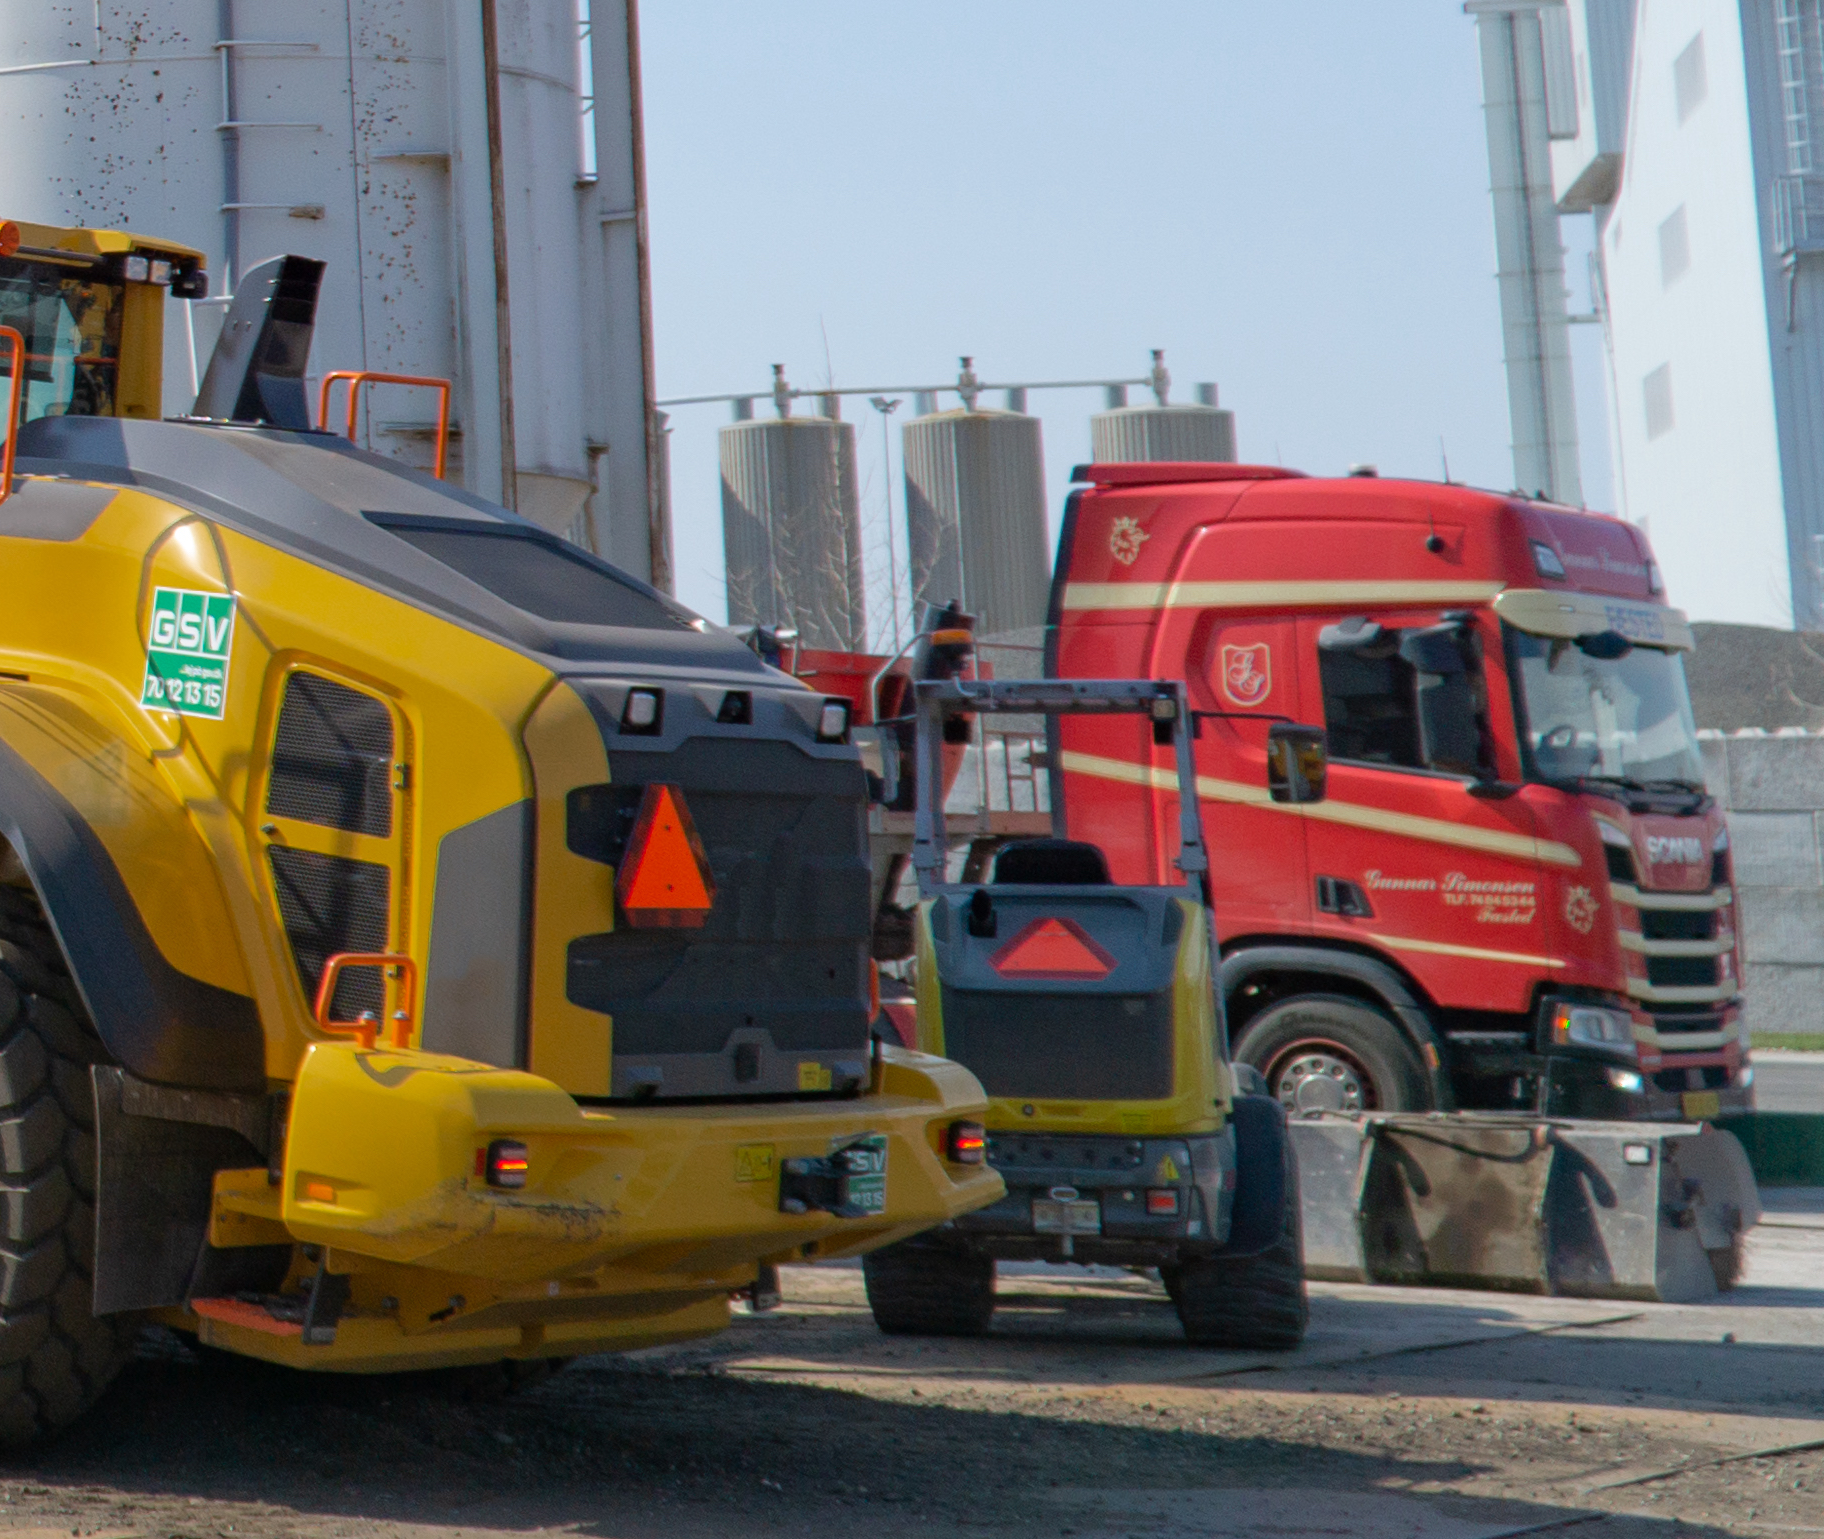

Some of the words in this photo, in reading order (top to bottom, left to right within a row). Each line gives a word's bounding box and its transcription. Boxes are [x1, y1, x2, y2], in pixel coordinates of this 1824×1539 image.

[153, 609, 230, 652] GSV
[146, 675, 165, 699] 70
[166, 678, 183, 702] 12
[184, 681, 202, 705] 13
[203, 684, 222, 708] 15
